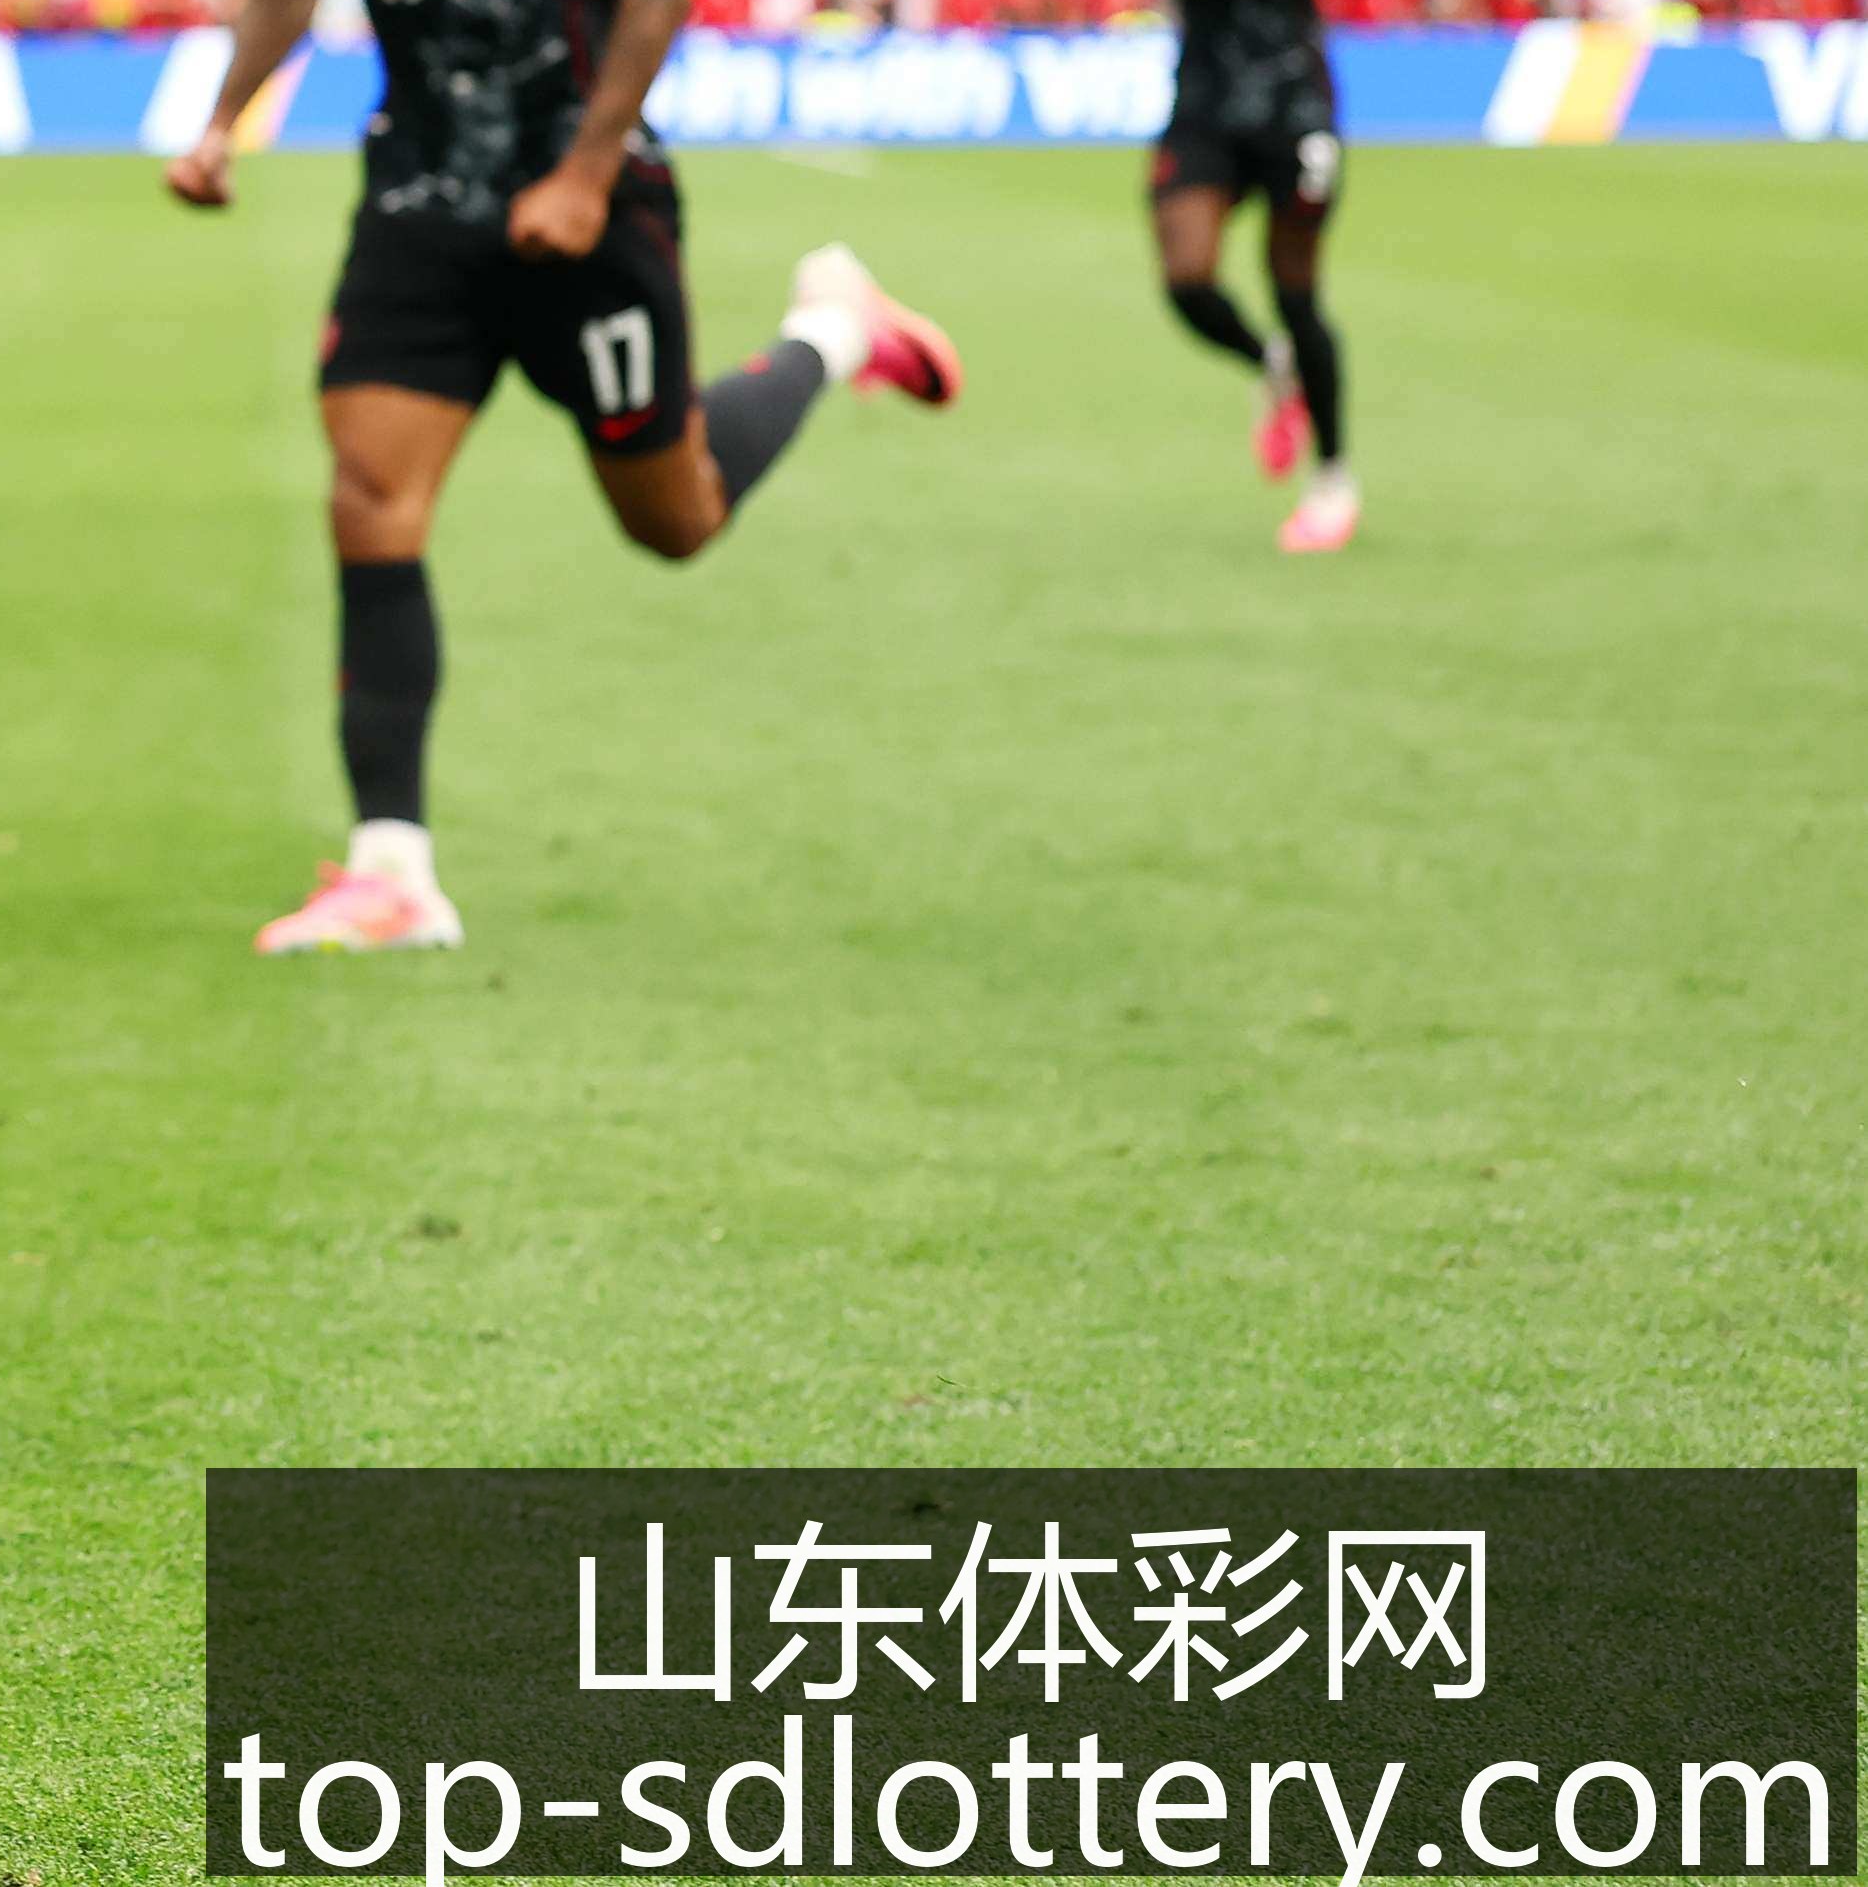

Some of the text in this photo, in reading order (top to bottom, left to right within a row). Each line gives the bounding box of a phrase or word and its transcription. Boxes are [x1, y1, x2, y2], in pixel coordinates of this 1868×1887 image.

[642, 28, 783, 140] in
[1019, 32, 1178, 139] VIS
[580, 306, 654, 413] 17
